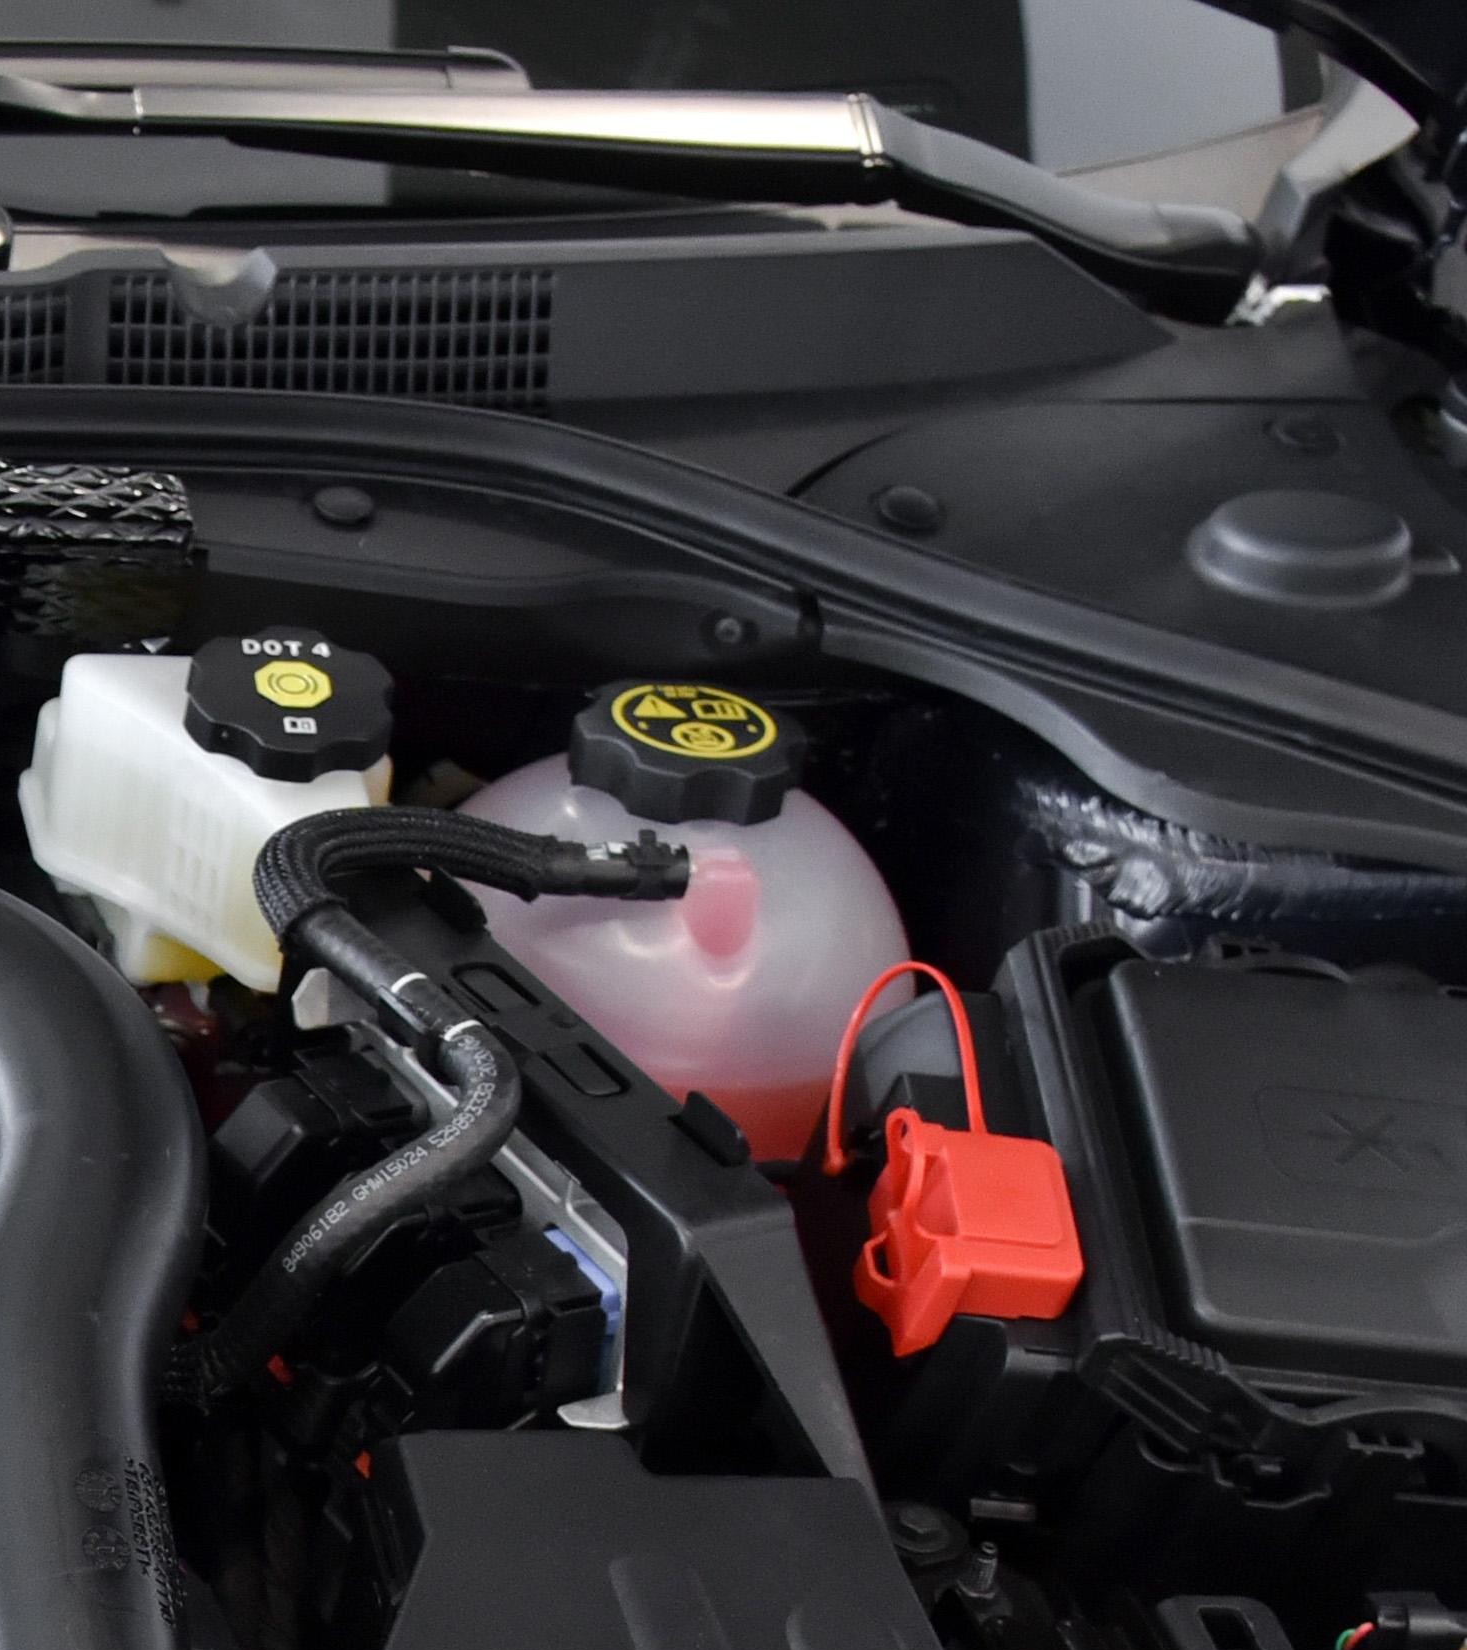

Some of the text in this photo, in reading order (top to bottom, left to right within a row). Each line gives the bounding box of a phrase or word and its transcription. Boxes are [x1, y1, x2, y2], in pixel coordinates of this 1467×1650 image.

[241, 638, 332, 658] DOT 4
[352, 1146, 428, 1202] GMW15024
